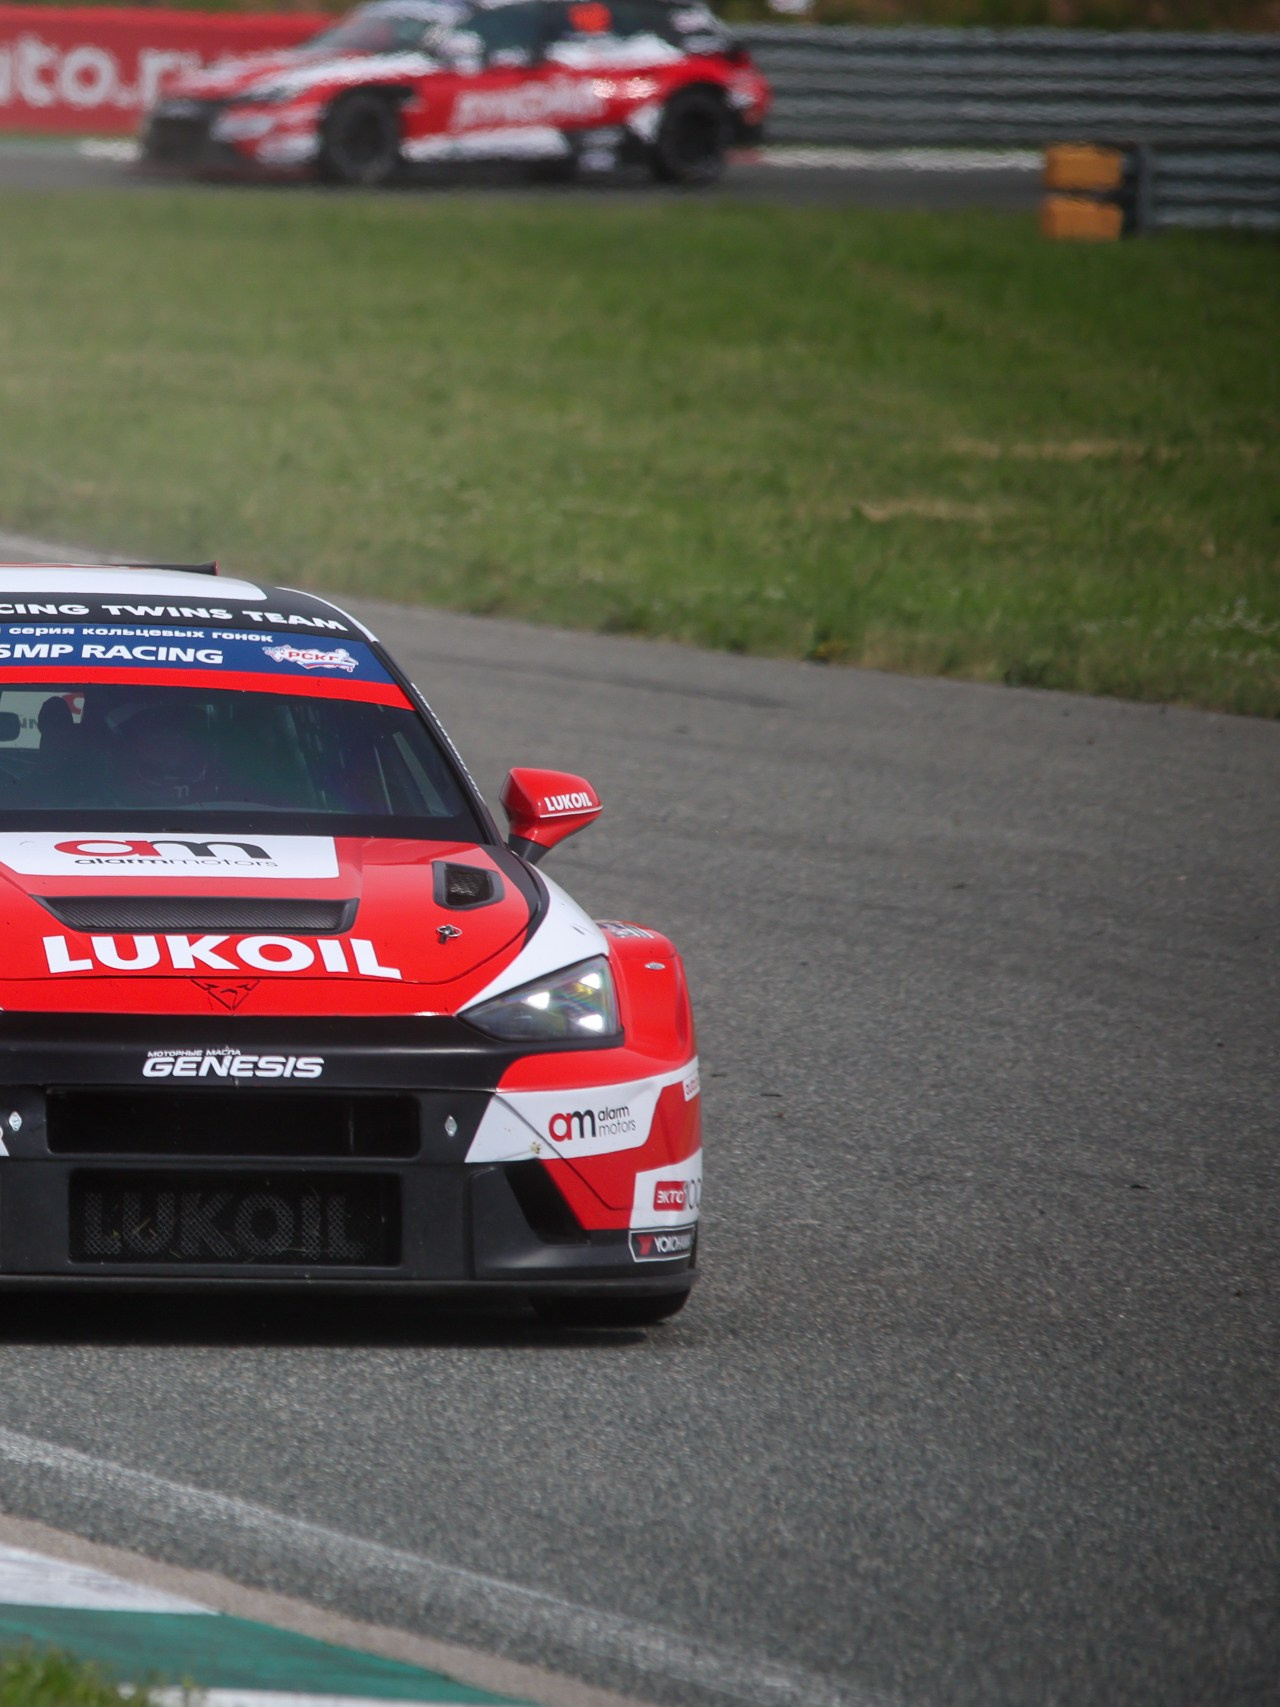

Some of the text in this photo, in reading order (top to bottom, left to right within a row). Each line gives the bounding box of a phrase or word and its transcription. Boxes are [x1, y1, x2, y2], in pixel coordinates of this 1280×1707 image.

[101, 604, 233, 621] TWINS
[242, 610, 349, 632] TEAM
[8, 627, 75, 636] серия
[82, 628, 205, 639] кольцевых
[211, 632, 274, 643] гонок
[81, 644, 224, 665] RACING
[544, 791, 593, 812] LUKOIL
[42, 934, 403, 981] LUKOIL
[142, 1055, 325, 1079] GENESIS
[598, 1105, 630, 1122] alarm
[598, 1119, 637, 1137] motors
[83, 1192, 366, 1260] LUKOIL
